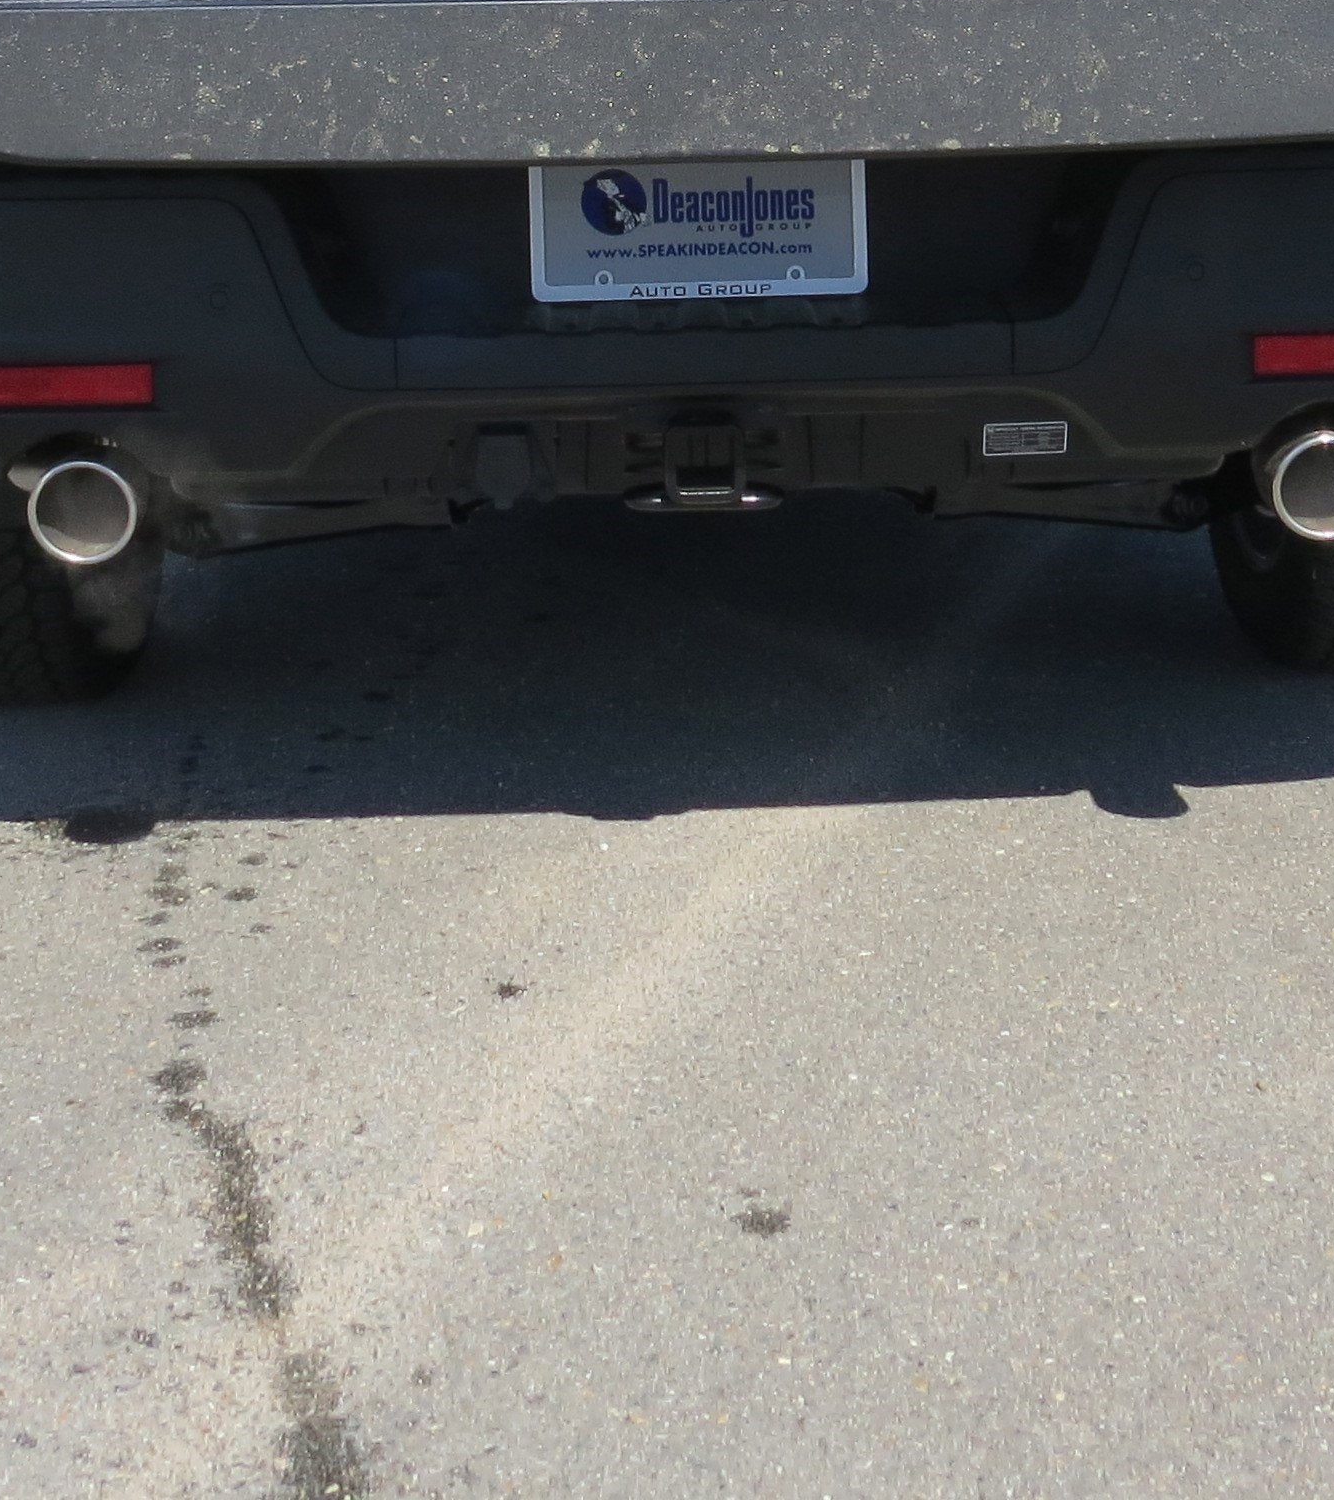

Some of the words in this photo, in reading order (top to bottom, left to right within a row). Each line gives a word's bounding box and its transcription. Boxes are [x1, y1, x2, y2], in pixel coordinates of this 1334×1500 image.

[695, 223, 738, 233] AUTO
[755, 222, 813, 232] GROUP
[586, 241, 813, 260] www.SPEAKINDEACON.com
